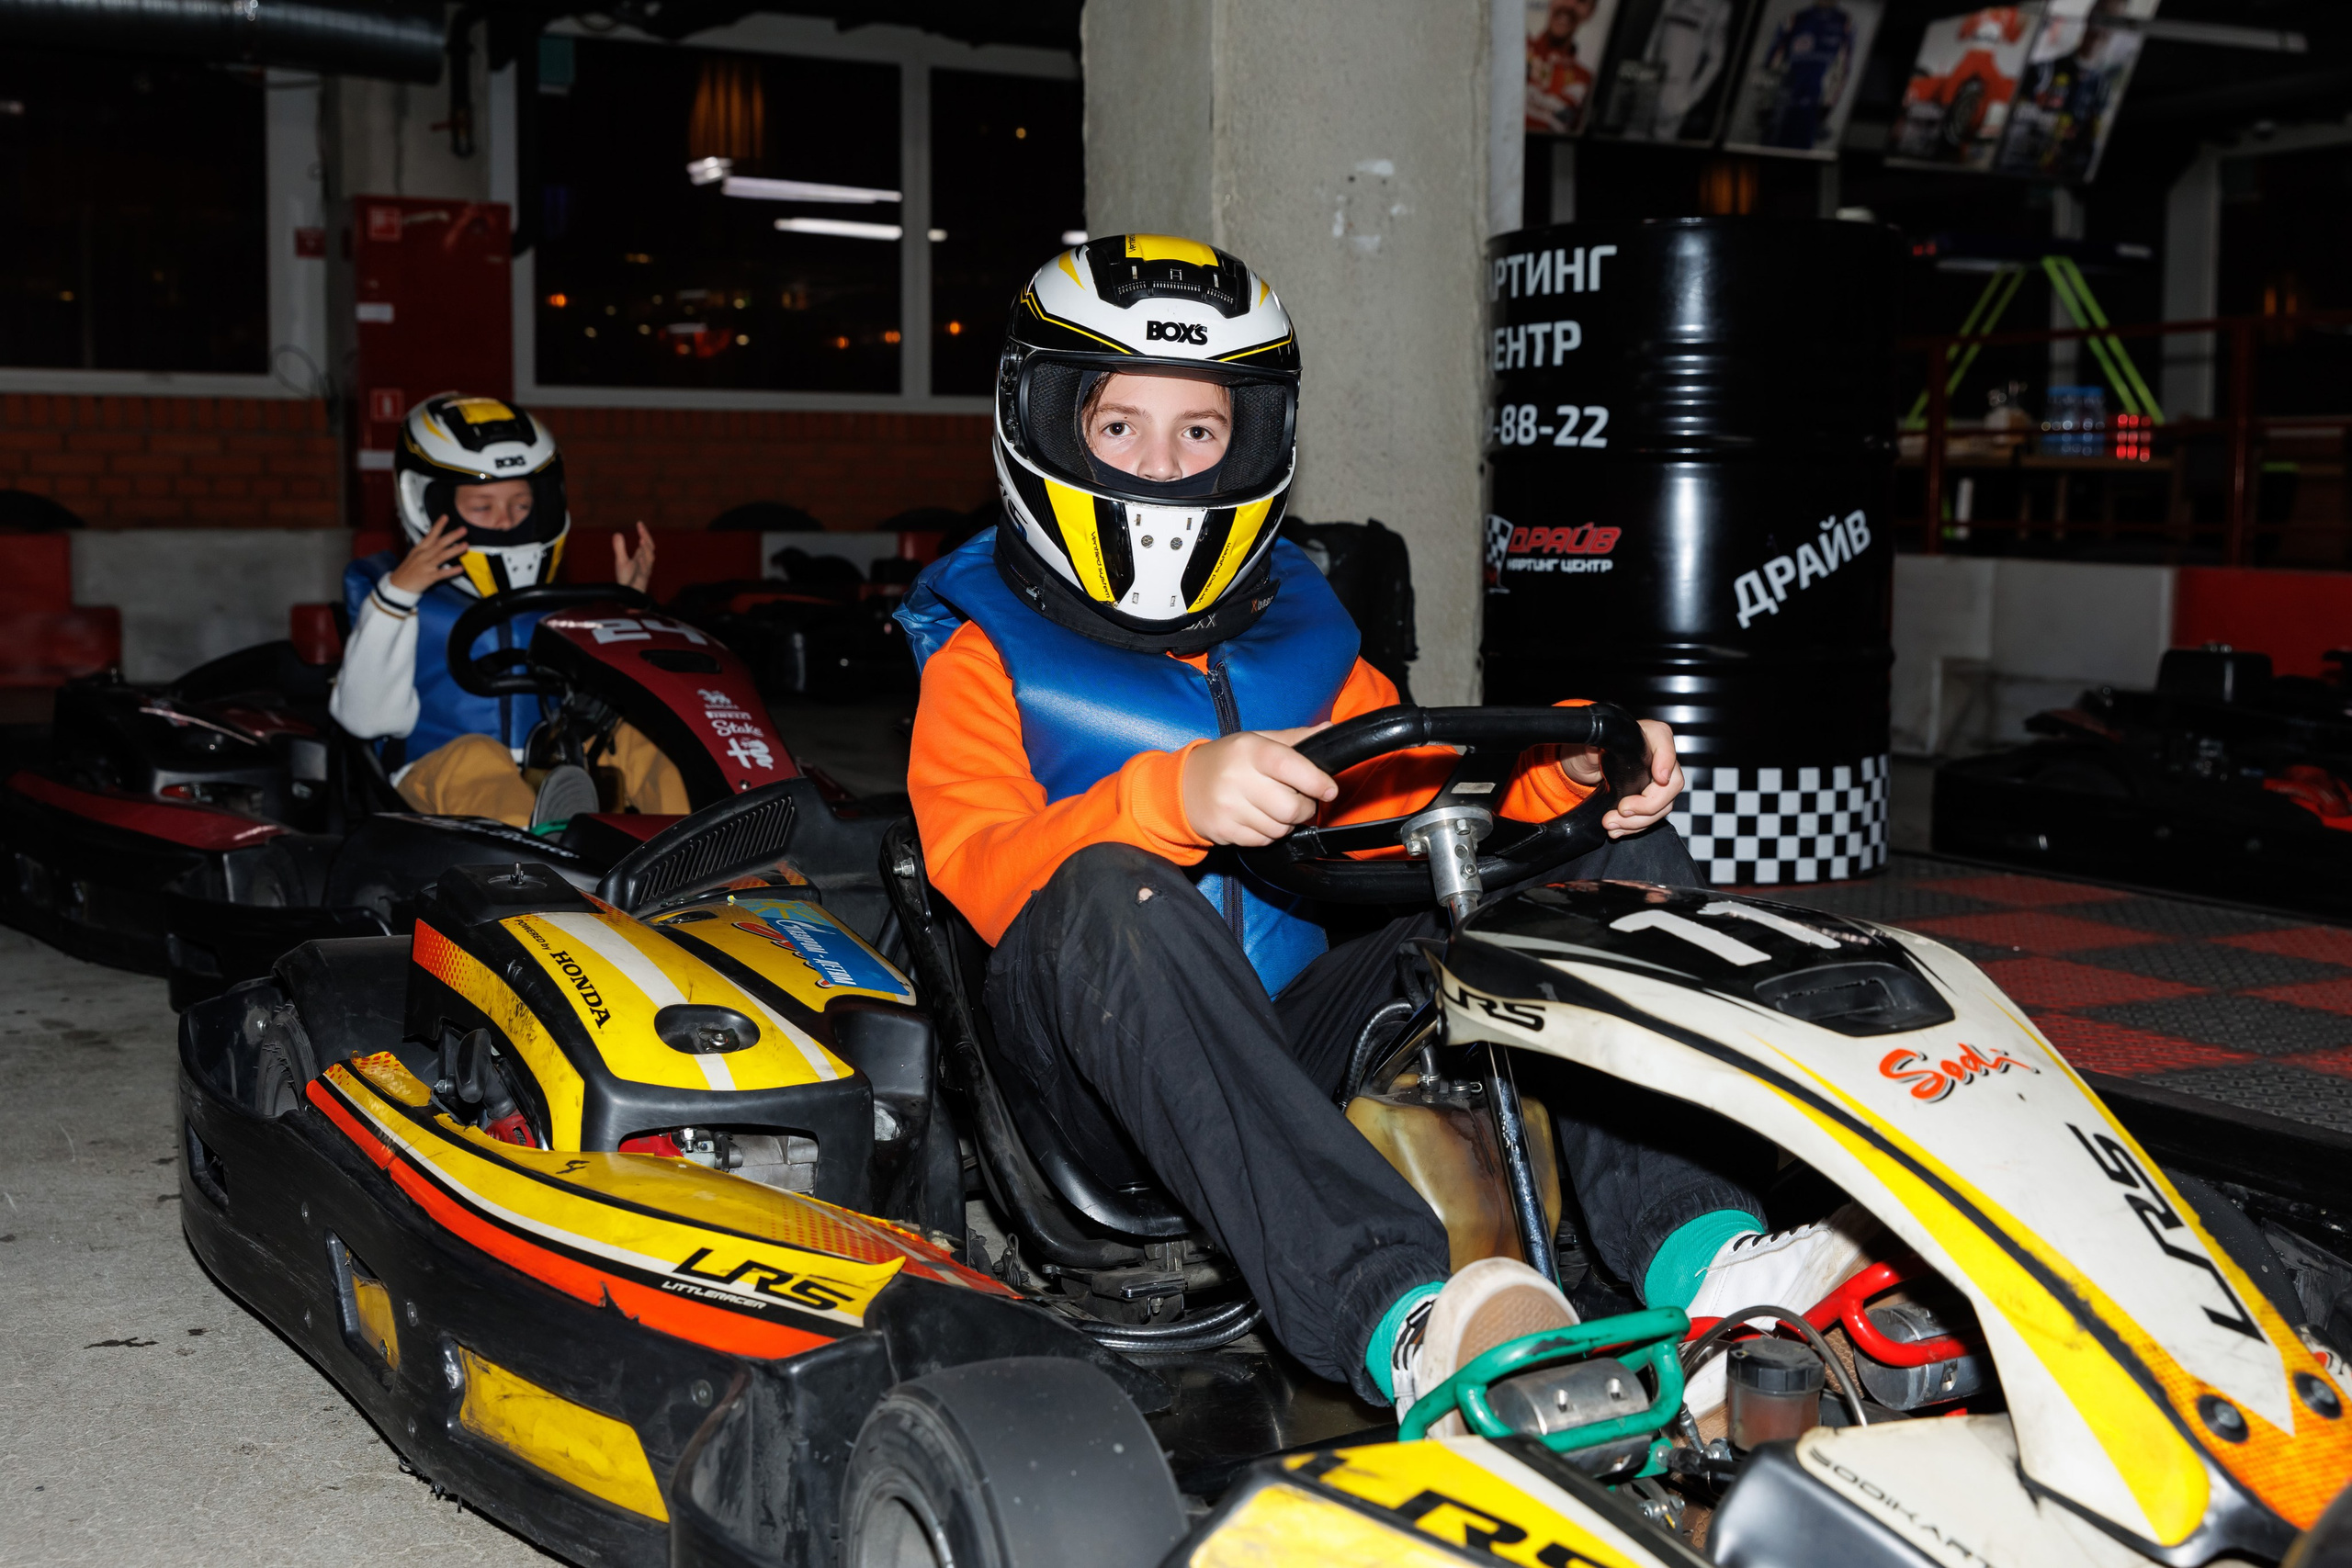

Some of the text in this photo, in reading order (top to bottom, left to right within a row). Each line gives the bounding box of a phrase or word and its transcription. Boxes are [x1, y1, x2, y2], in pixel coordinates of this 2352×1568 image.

[1490, 245, 1618, 302] РТИНГ
[1494, 320, 1582, 371] ЕНТР
[1509, 522, 1622, 554] ДРАЙВ
[1215, 542, 1232, 573] system
[1734, 510, 1871, 629] ДРАЙВ
[1098, 568, 1111, 598] system
[589, 618, 708, 645] 24
[711, 719, 764, 737] Stake
[514, 919, 552, 951] POWERED by
[549, 950, 611, 1029] HONDA
[1879, 1043, 2041, 1103] Sodi
[662, 1280, 767, 1310] LITTLERACER
[672, 1247, 855, 1311] LRS
